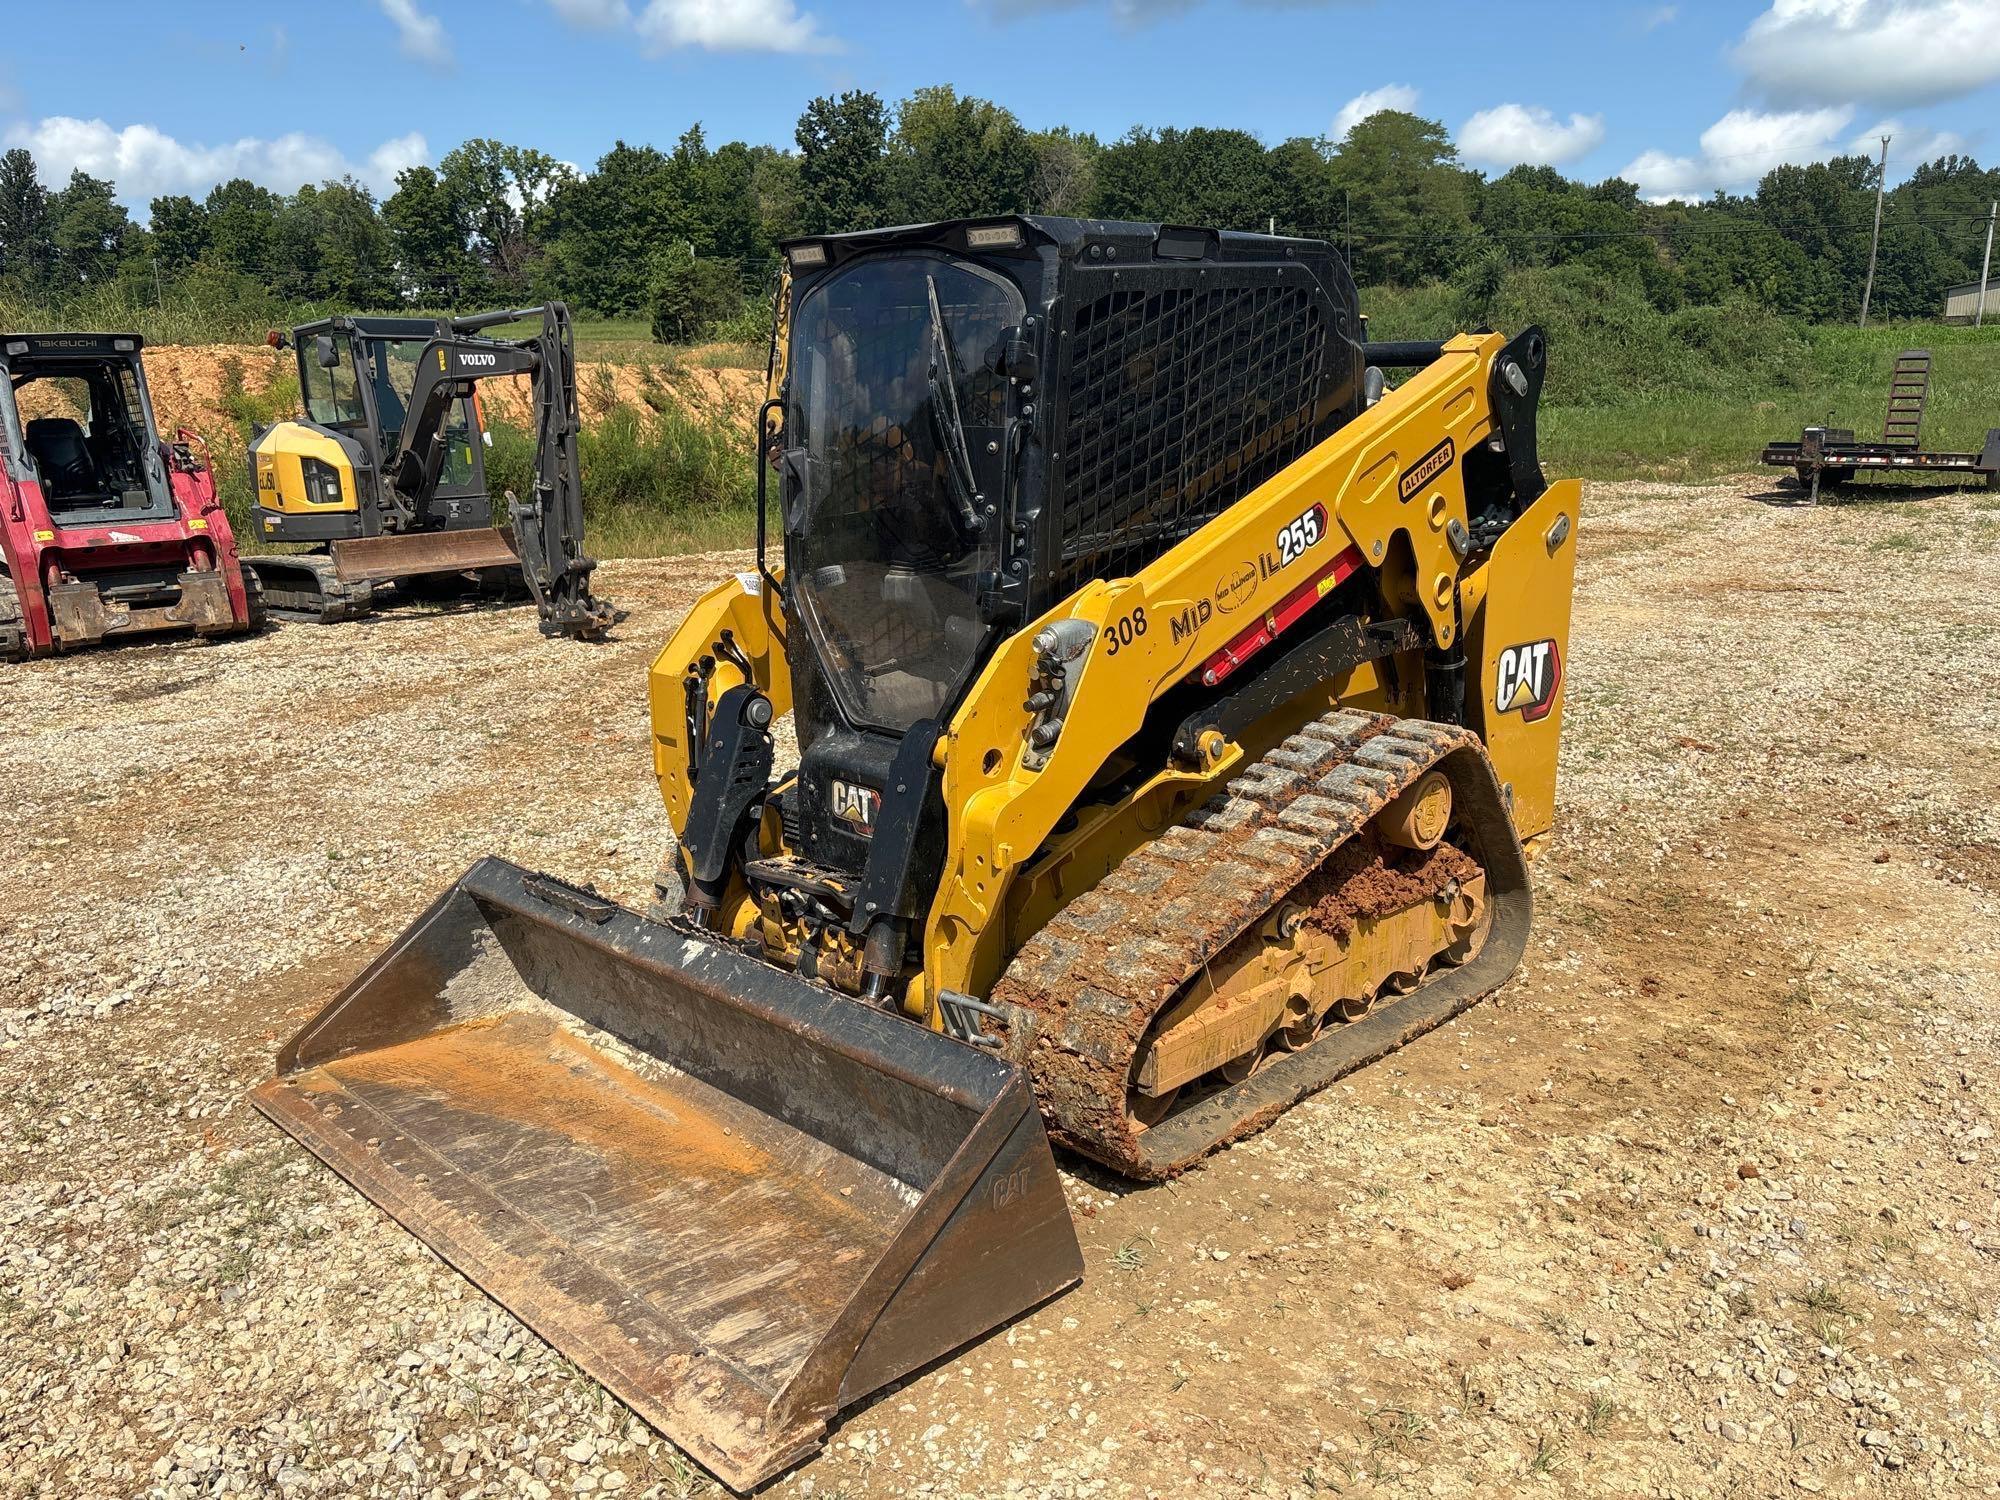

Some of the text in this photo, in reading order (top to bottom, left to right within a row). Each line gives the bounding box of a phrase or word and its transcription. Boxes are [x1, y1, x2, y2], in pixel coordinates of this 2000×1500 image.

[34, 340, 98, 348] TAKEUCHI
[459, 354, 496, 366] VOLVO
[1405, 447, 1450, 493] ALTORFER
[1278, 508, 1318, 567] 255
[1170, 552, 1281, 646] MID IL
[1217, 569, 1256, 601] MID ILLINOIS
[1104, 606, 1148, 656] 308
[1497, 642, 1549, 711] CAT
[833, 781, 872, 824] CAT
[993, 1167, 1031, 1210] CAT
